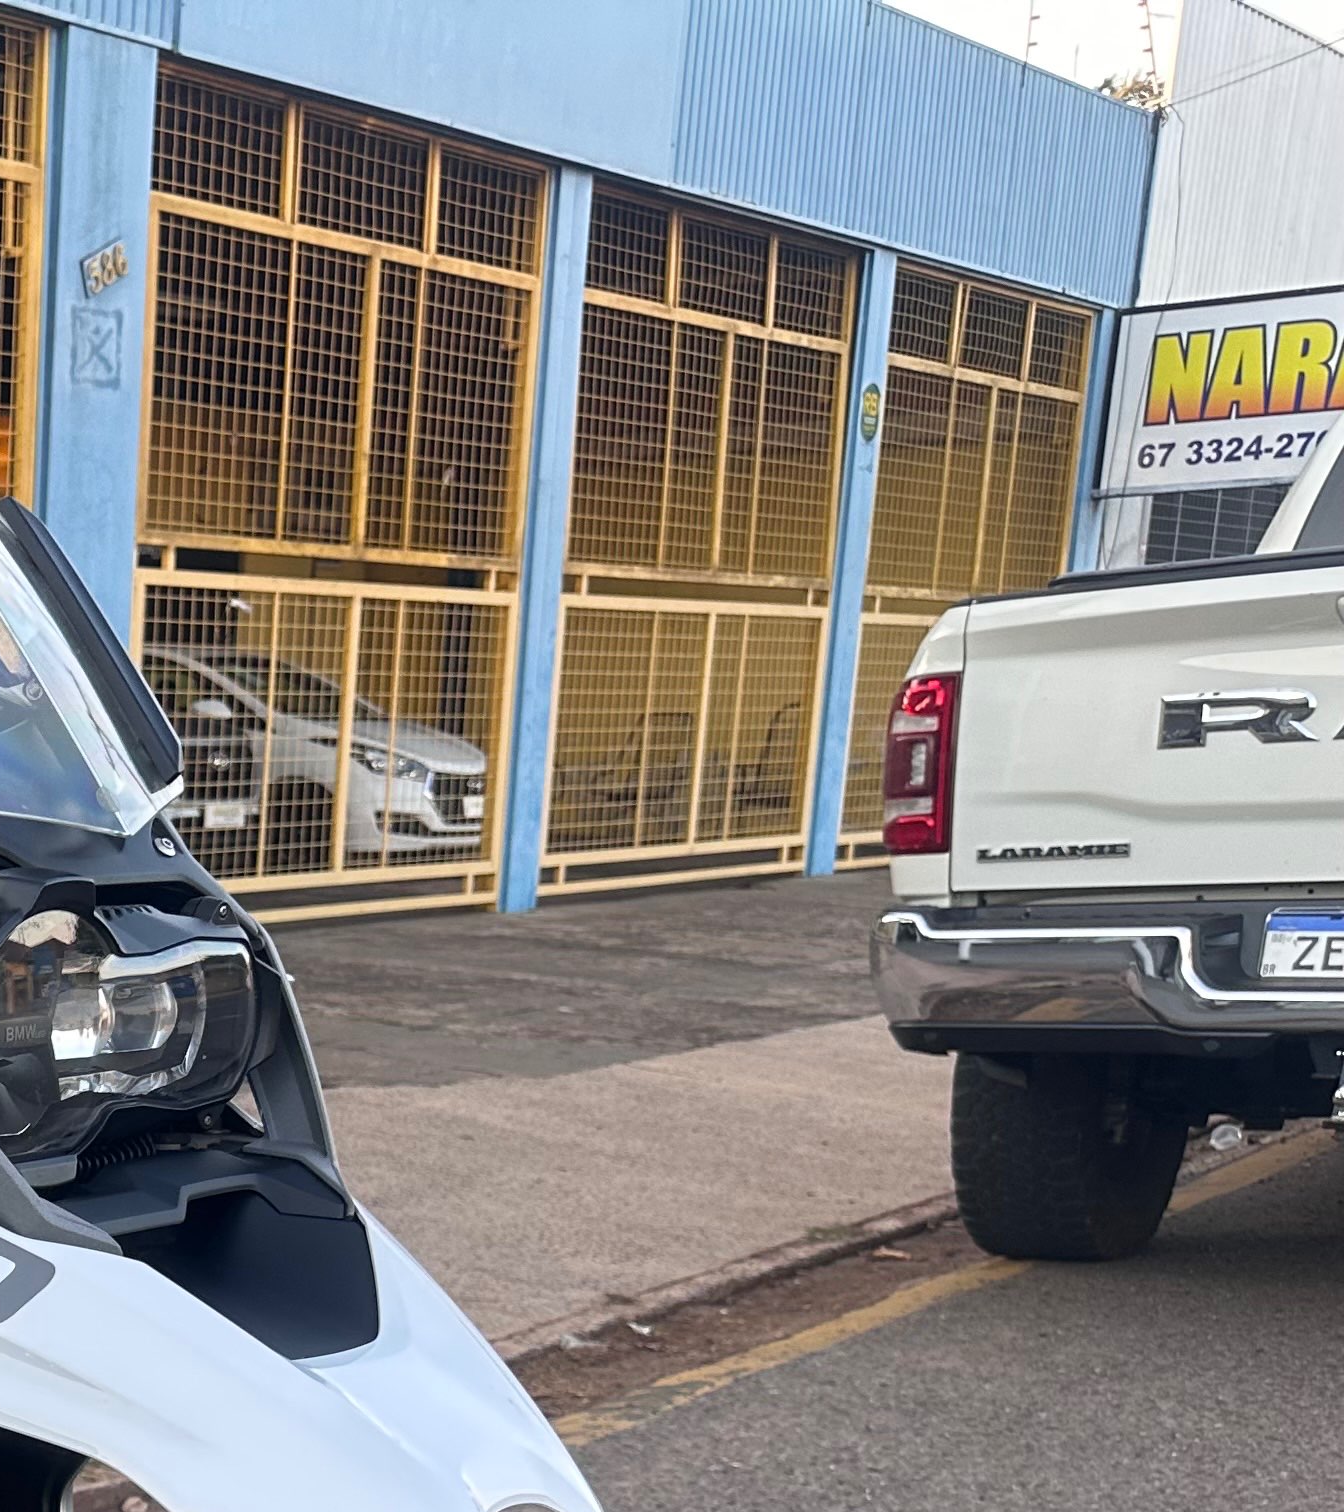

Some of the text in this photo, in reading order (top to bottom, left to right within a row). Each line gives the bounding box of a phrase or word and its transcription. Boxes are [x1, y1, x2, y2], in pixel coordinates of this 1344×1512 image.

[88, 244, 128, 293] 586
[1143, 318, 1344, 427] NAR
[1137, 442, 1176, 469] 67
[1157, 687, 1344, 750] R
[976, 842, 1130, 864] LARAMIE
[6, 1023, 36, 1043] BMW
